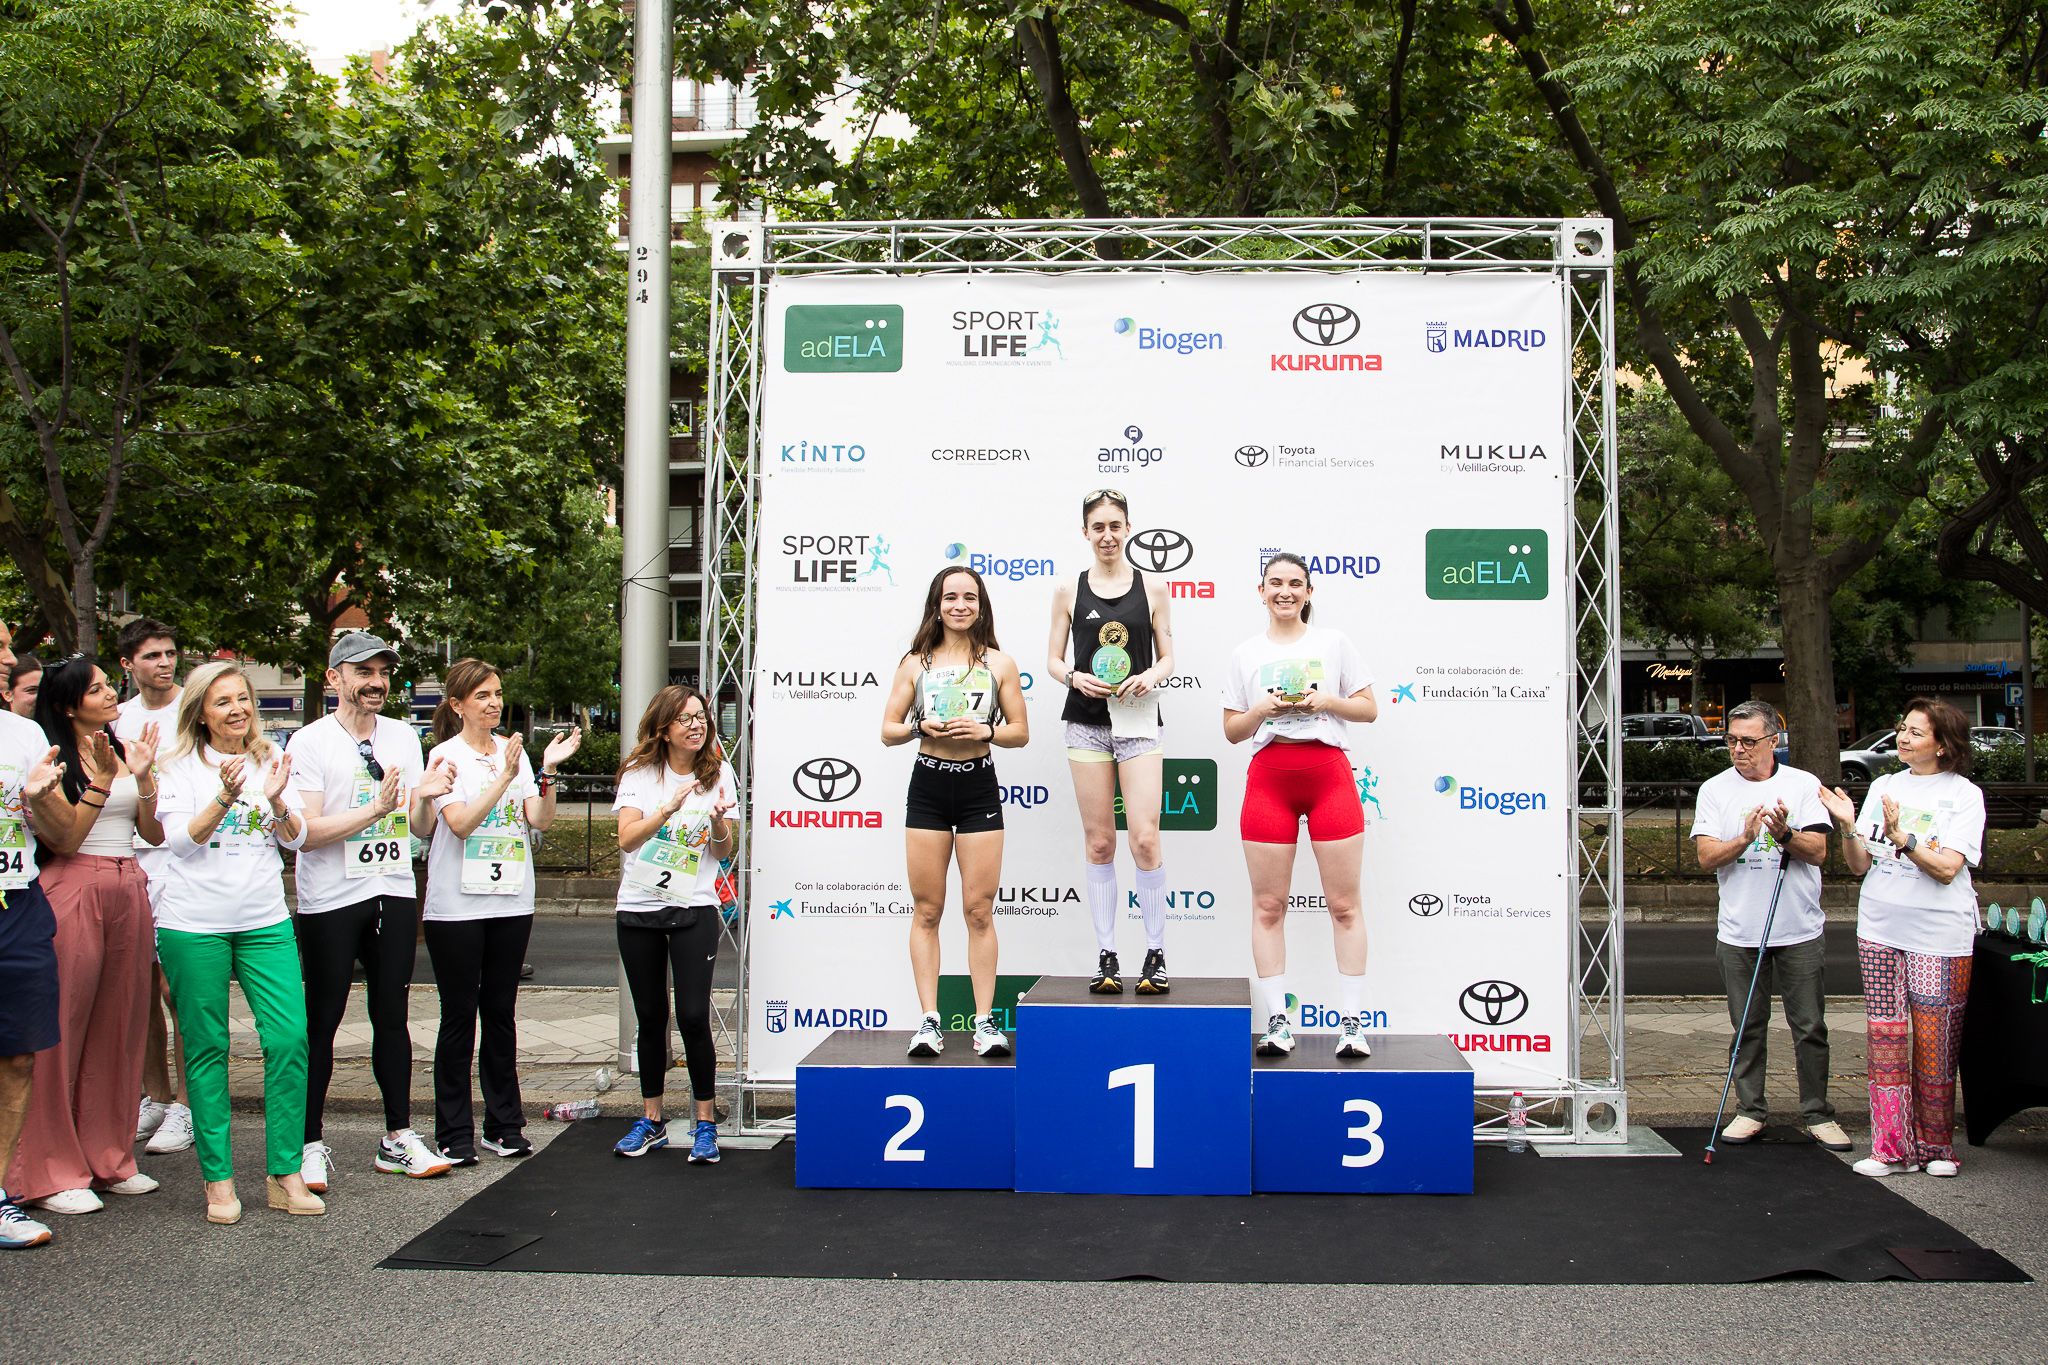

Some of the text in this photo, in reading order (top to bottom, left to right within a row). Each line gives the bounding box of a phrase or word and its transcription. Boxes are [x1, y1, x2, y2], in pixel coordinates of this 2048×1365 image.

[952, 310, 1039, 331] SPORT
[801, 335, 886, 358] adELA
[964, 334, 1027, 357] LIFE
[1138, 327, 1224, 355] Biogen
[1454, 329, 1546, 352] MADRID
[1097, 447, 1163, 467] amigo
[1278, 445, 1316, 456] Toyota
[1441, 444, 1547, 460] MUKUA
[1098, 464, 1130, 473] tours
[1278, 457, 1375, 468] Financial Services
[1456, 463, 1526, 475] VelillaGroup.
[782, 535, 870, 555] SPORT
[794, 560, 857, 582] LIFE
[969, 553, 1055, 582] Biogen
[1301, 556, 1381, 579] ADRID
[1442, 561, 1532, 584] adELA
[773, 671, 879, 686] MUKUA
[1416, 666, 1524, 675] Con la colaboración de:
[788, 689, 857, 701] VelillaGroup.
[1422, 685, 1489, 698] Fundación
[1905, 683, 1937, 692] Centro
[1939, 682, 1951, 691] de
[2010, 686, 2023, 704] P
[938, 762, 975, 773] PRO
[1000, 785, 1049, 809] DRID
[1460, 786, 1547, 816] Biogen
[358, 841, 401, 863] 698
[490, 863, 502, 882] 3
[655, 870, 672, 890] 2
[794, 881, 902, 891] Con la colaboración de:
[998, 887, 1081, 903] UKUA
[800, 901, 867, 914] Fundación
[1453, 894, 1491, 906] Toyota
[1453, 906, 1552, 919] Financial Services
[794, 1008, 889, 1031] MADRID
[1301, 1004, 1388, 1028] Bioen
[1107, 1063, 1155, 1169] 1
[883, 1094, 926, 1162] 2
[1341, 1099, 1385, 1168] 3
